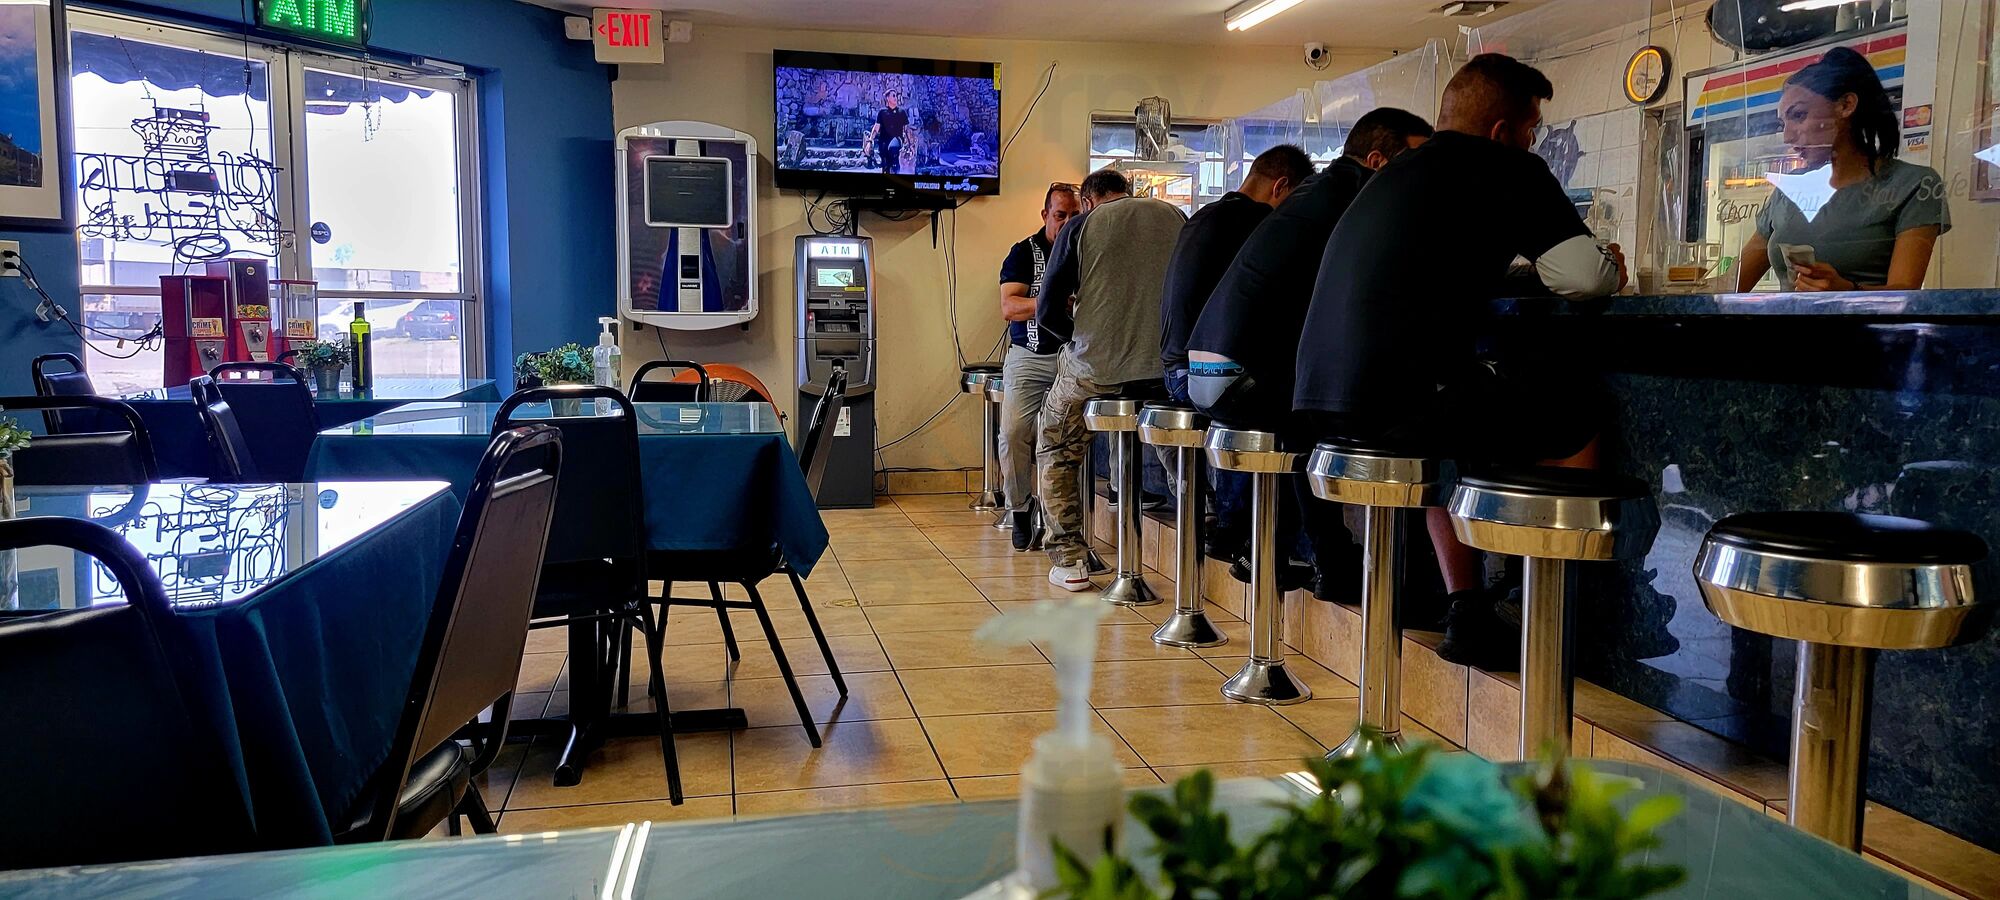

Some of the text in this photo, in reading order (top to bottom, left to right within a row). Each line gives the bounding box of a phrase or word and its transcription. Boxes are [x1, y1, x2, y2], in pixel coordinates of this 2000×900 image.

[271, 0, 355, 37] ATM
[607, 12, 651, 47] EXIT
[1907, 137, 1925, 146] VISA
[1716, 195, 1770, 224] Thank
[1860, 182, 1900, 212] Stay
[1916, 171, 1968, 201] Safe
[820, 245, 851, 255] ATM
[192, 320, 212, 329] CRIME
[288, 320, 305, 329] CRIME
